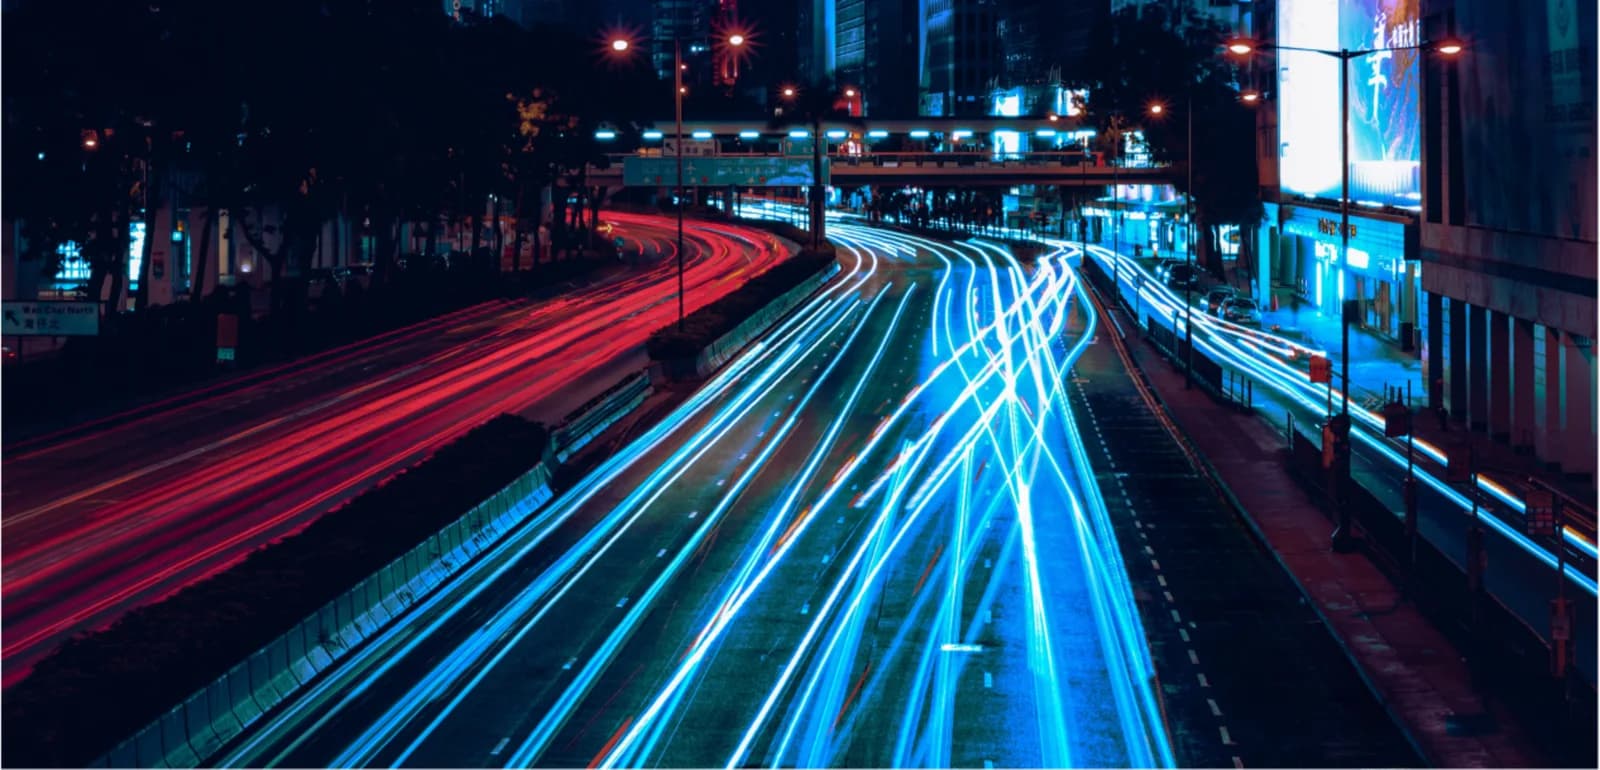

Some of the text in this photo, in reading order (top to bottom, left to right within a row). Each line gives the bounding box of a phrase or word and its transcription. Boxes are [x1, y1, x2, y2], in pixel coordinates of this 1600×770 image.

[22, 305, 94, 314] Wan Chai North
